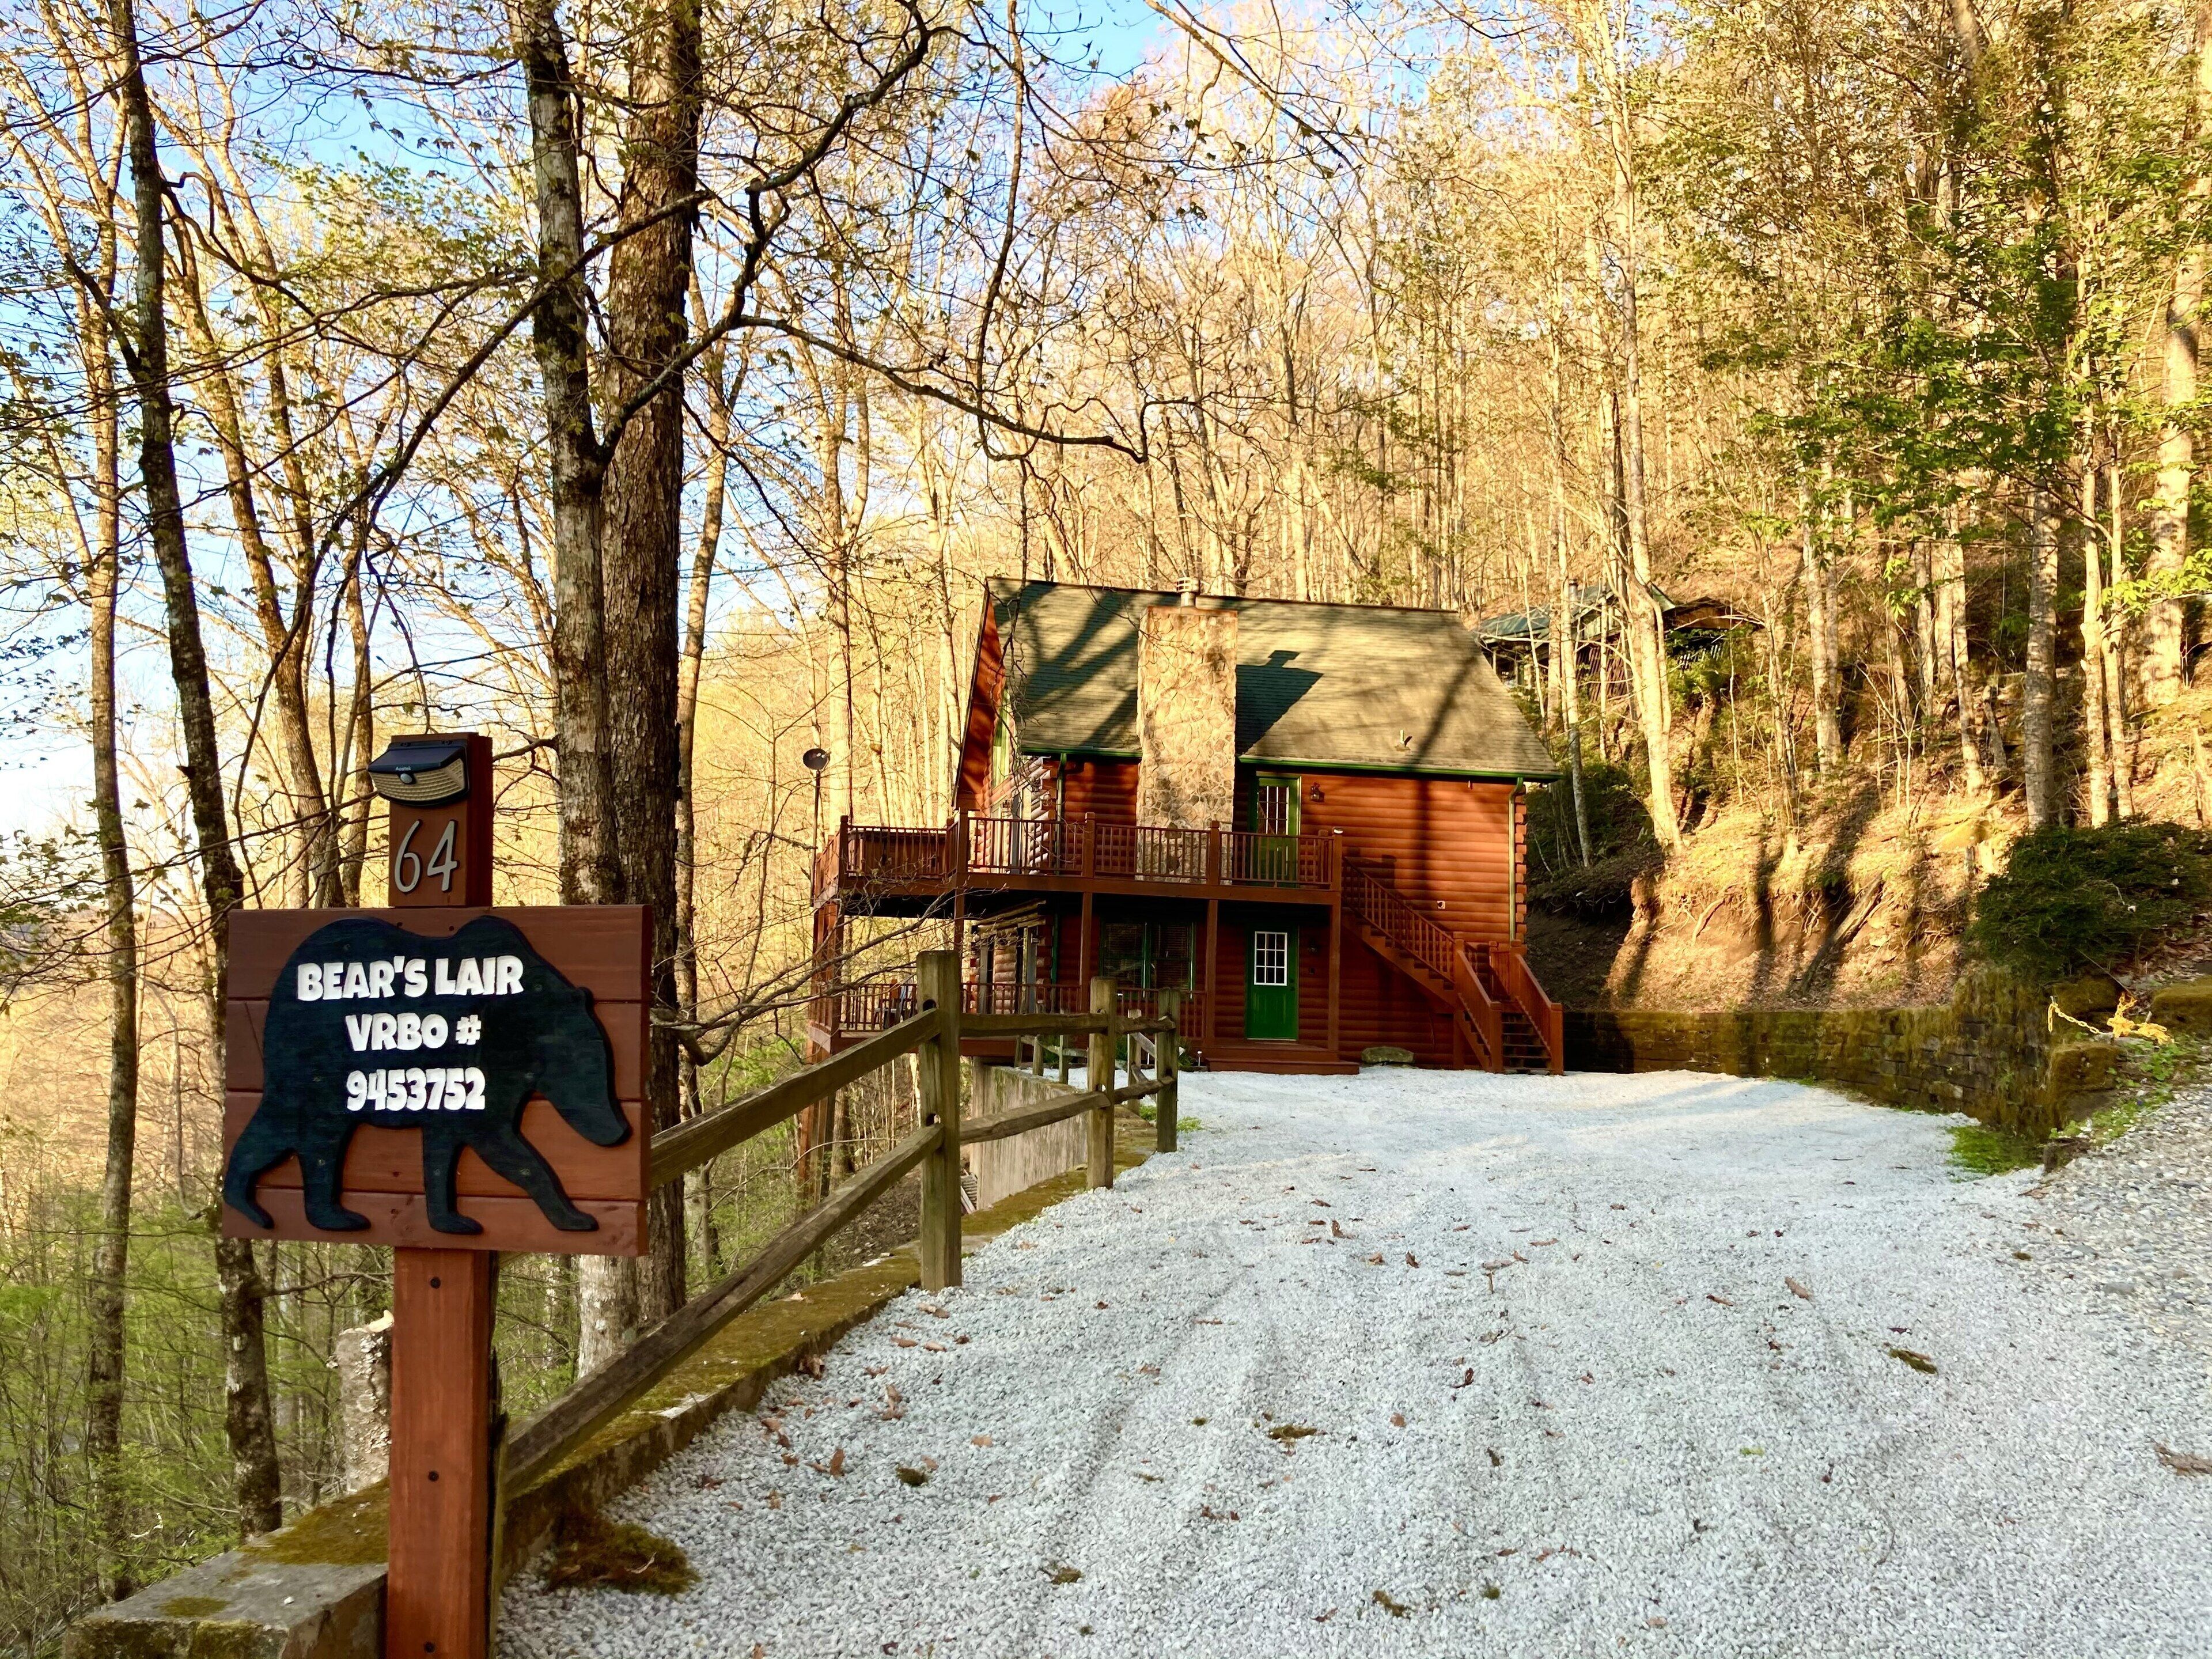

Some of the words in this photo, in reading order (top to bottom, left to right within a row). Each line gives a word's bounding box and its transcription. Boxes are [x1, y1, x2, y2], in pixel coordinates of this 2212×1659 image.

[395, 820, 458, 892] 64
[297, 955, 428, 1001] BEAR'S
[435, 955, 524, 995] LAIR
[346, 1012, 449, 1051] VRBO
[455, 1014, 482, 1046] #
[346, 1067, 486, 1111] 9453752
